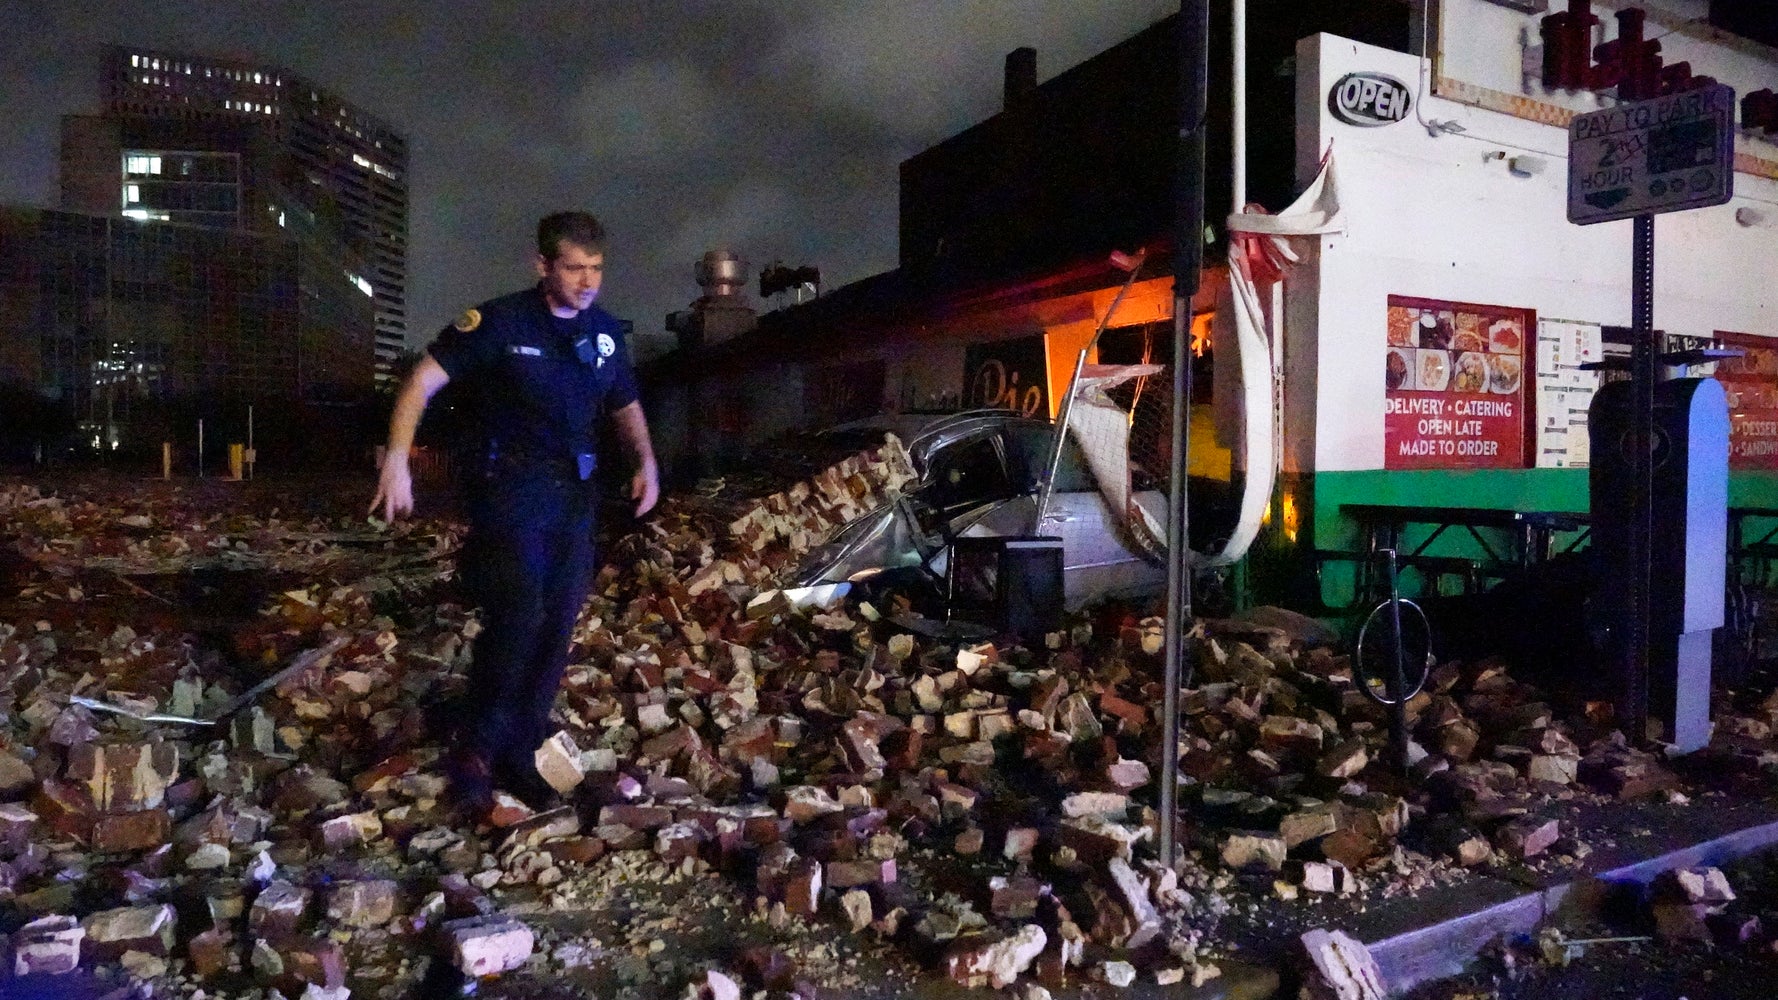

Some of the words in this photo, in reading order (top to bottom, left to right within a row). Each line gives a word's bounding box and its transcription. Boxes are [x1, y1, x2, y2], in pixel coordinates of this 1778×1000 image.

[1342, 77, 1407, 120] OPEN
[1576, 115, 1613, 139] PAY
[1625, 106, 1650, 130] TO
[1599, 138, 1616, 167] 2
[1581, 167, 1633, 190] HOUR
[1385, 398, 1445, 415] DELIVERY
[1455, 400, 1512, 417] CATERING
[1418, 419, 1452, 435] OPEN
[1455, 420, 1482, 436] LATE
[1742, 421, 1778, 436] DESSER
[1399, 441, 1436, 456] MADE
[1438, 441, 1455, 456] TO
[1457, 441, 1498, 456] ORDER
